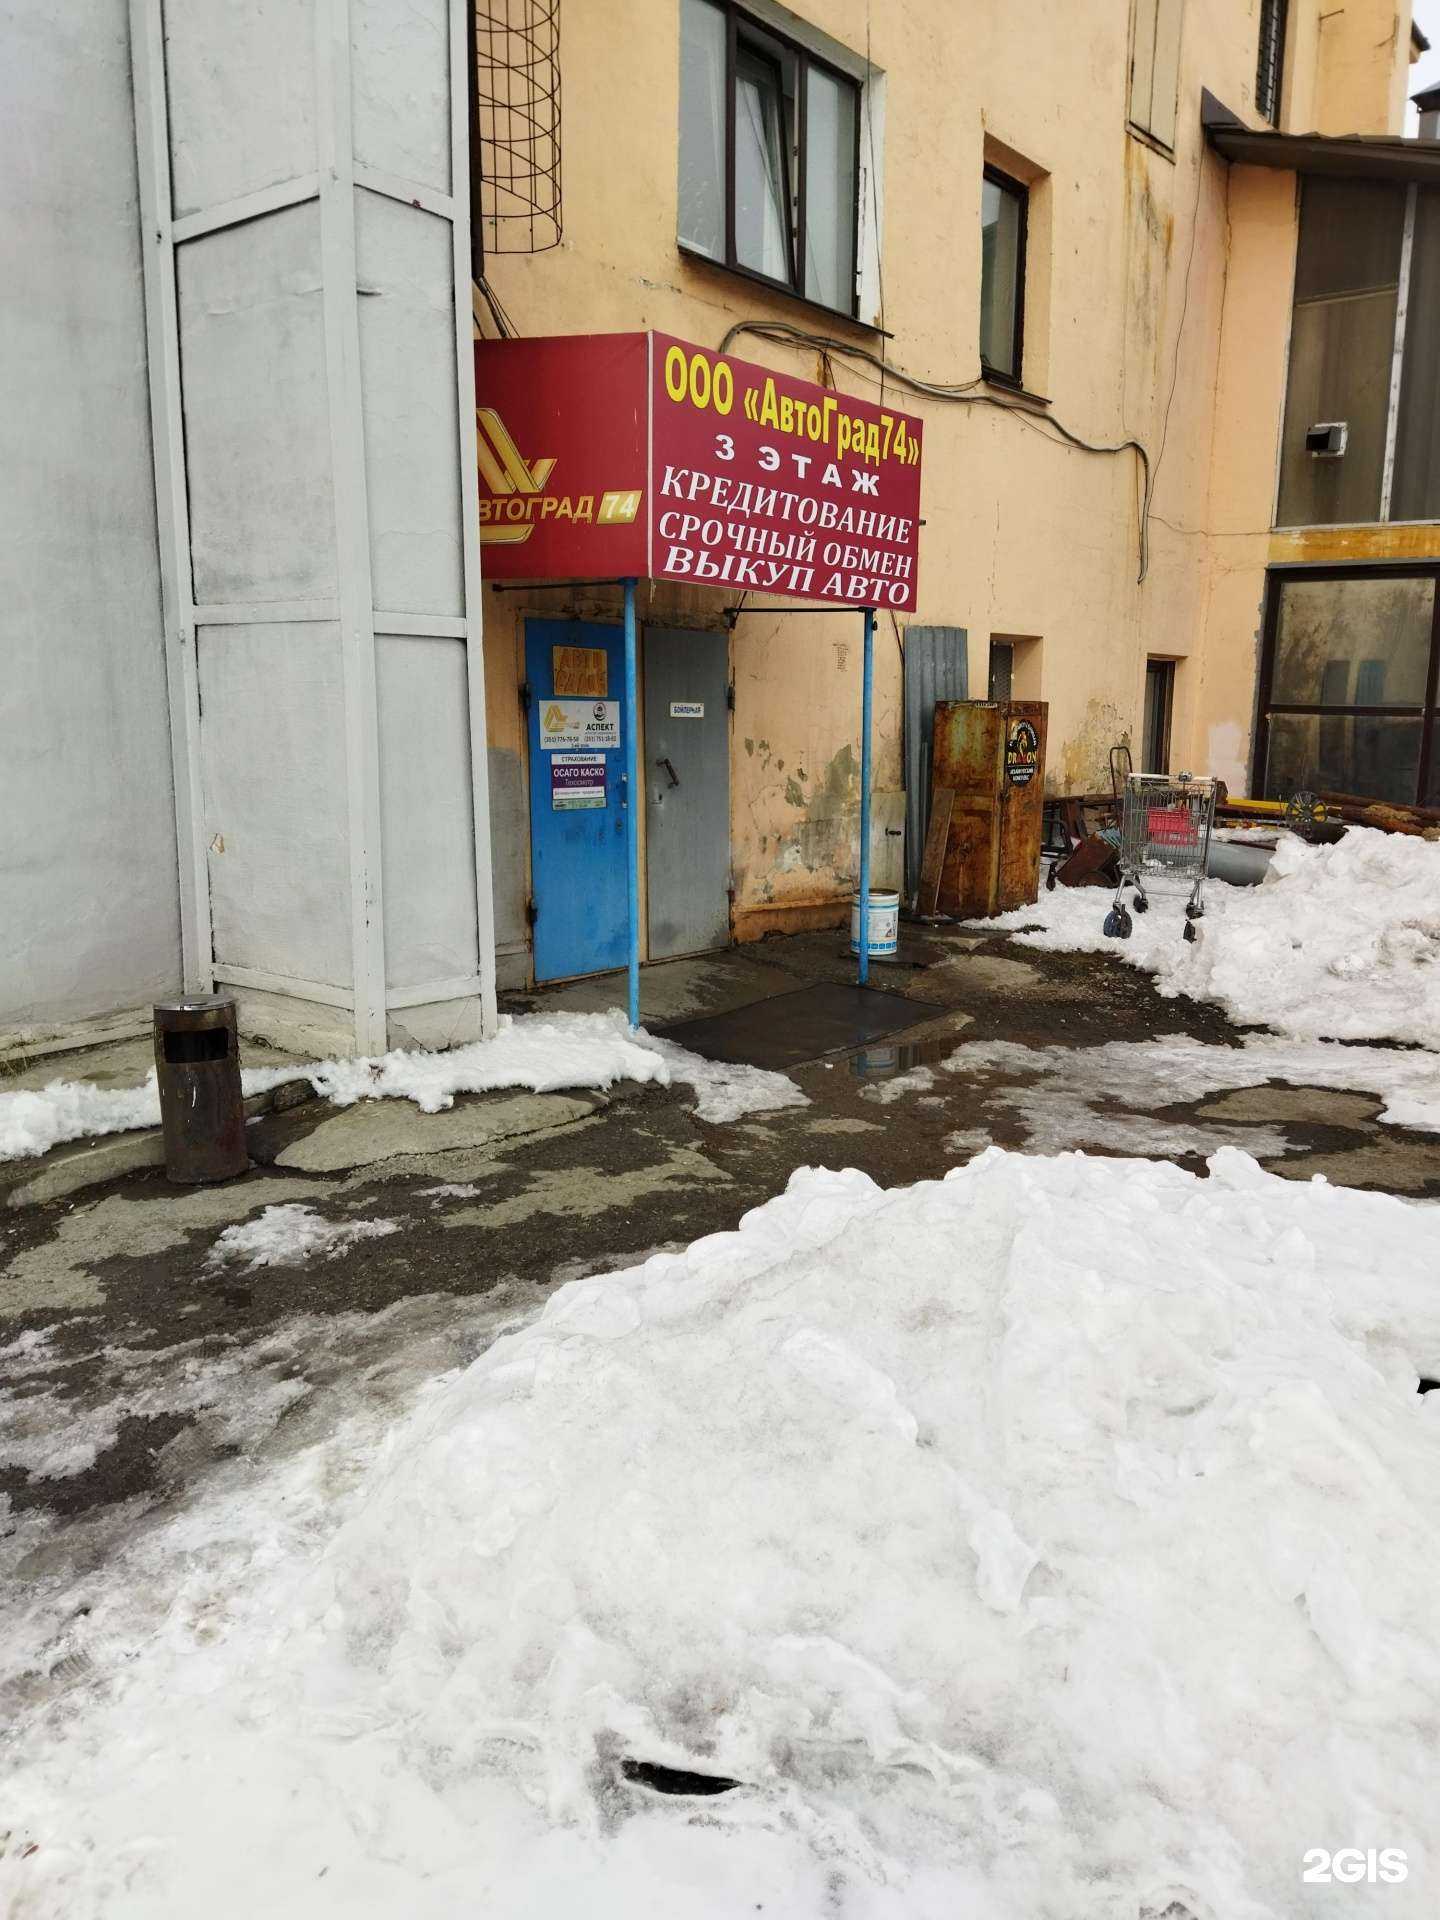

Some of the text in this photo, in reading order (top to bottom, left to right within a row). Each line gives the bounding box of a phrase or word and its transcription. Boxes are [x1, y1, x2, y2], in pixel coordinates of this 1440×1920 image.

[665, 345, 919, 467] ООО «АвтоГрад74»
[715, 434, 880, 496] 3 ЭТАЖ
[479, 494, 635, 524] ВТОГРАД 74
[660, 465, 913, 544] КРЕДИТОВАНИЕ
[659, 511, 913, 578] СРОЧНЫЙ ОБМЕН
[663, 545, 910, 604] ВЫКУП АВТО
[585, 723, 614, 731] АСПЕКТ
[553, 768, 605, 777] ОСАГО КАСКО
